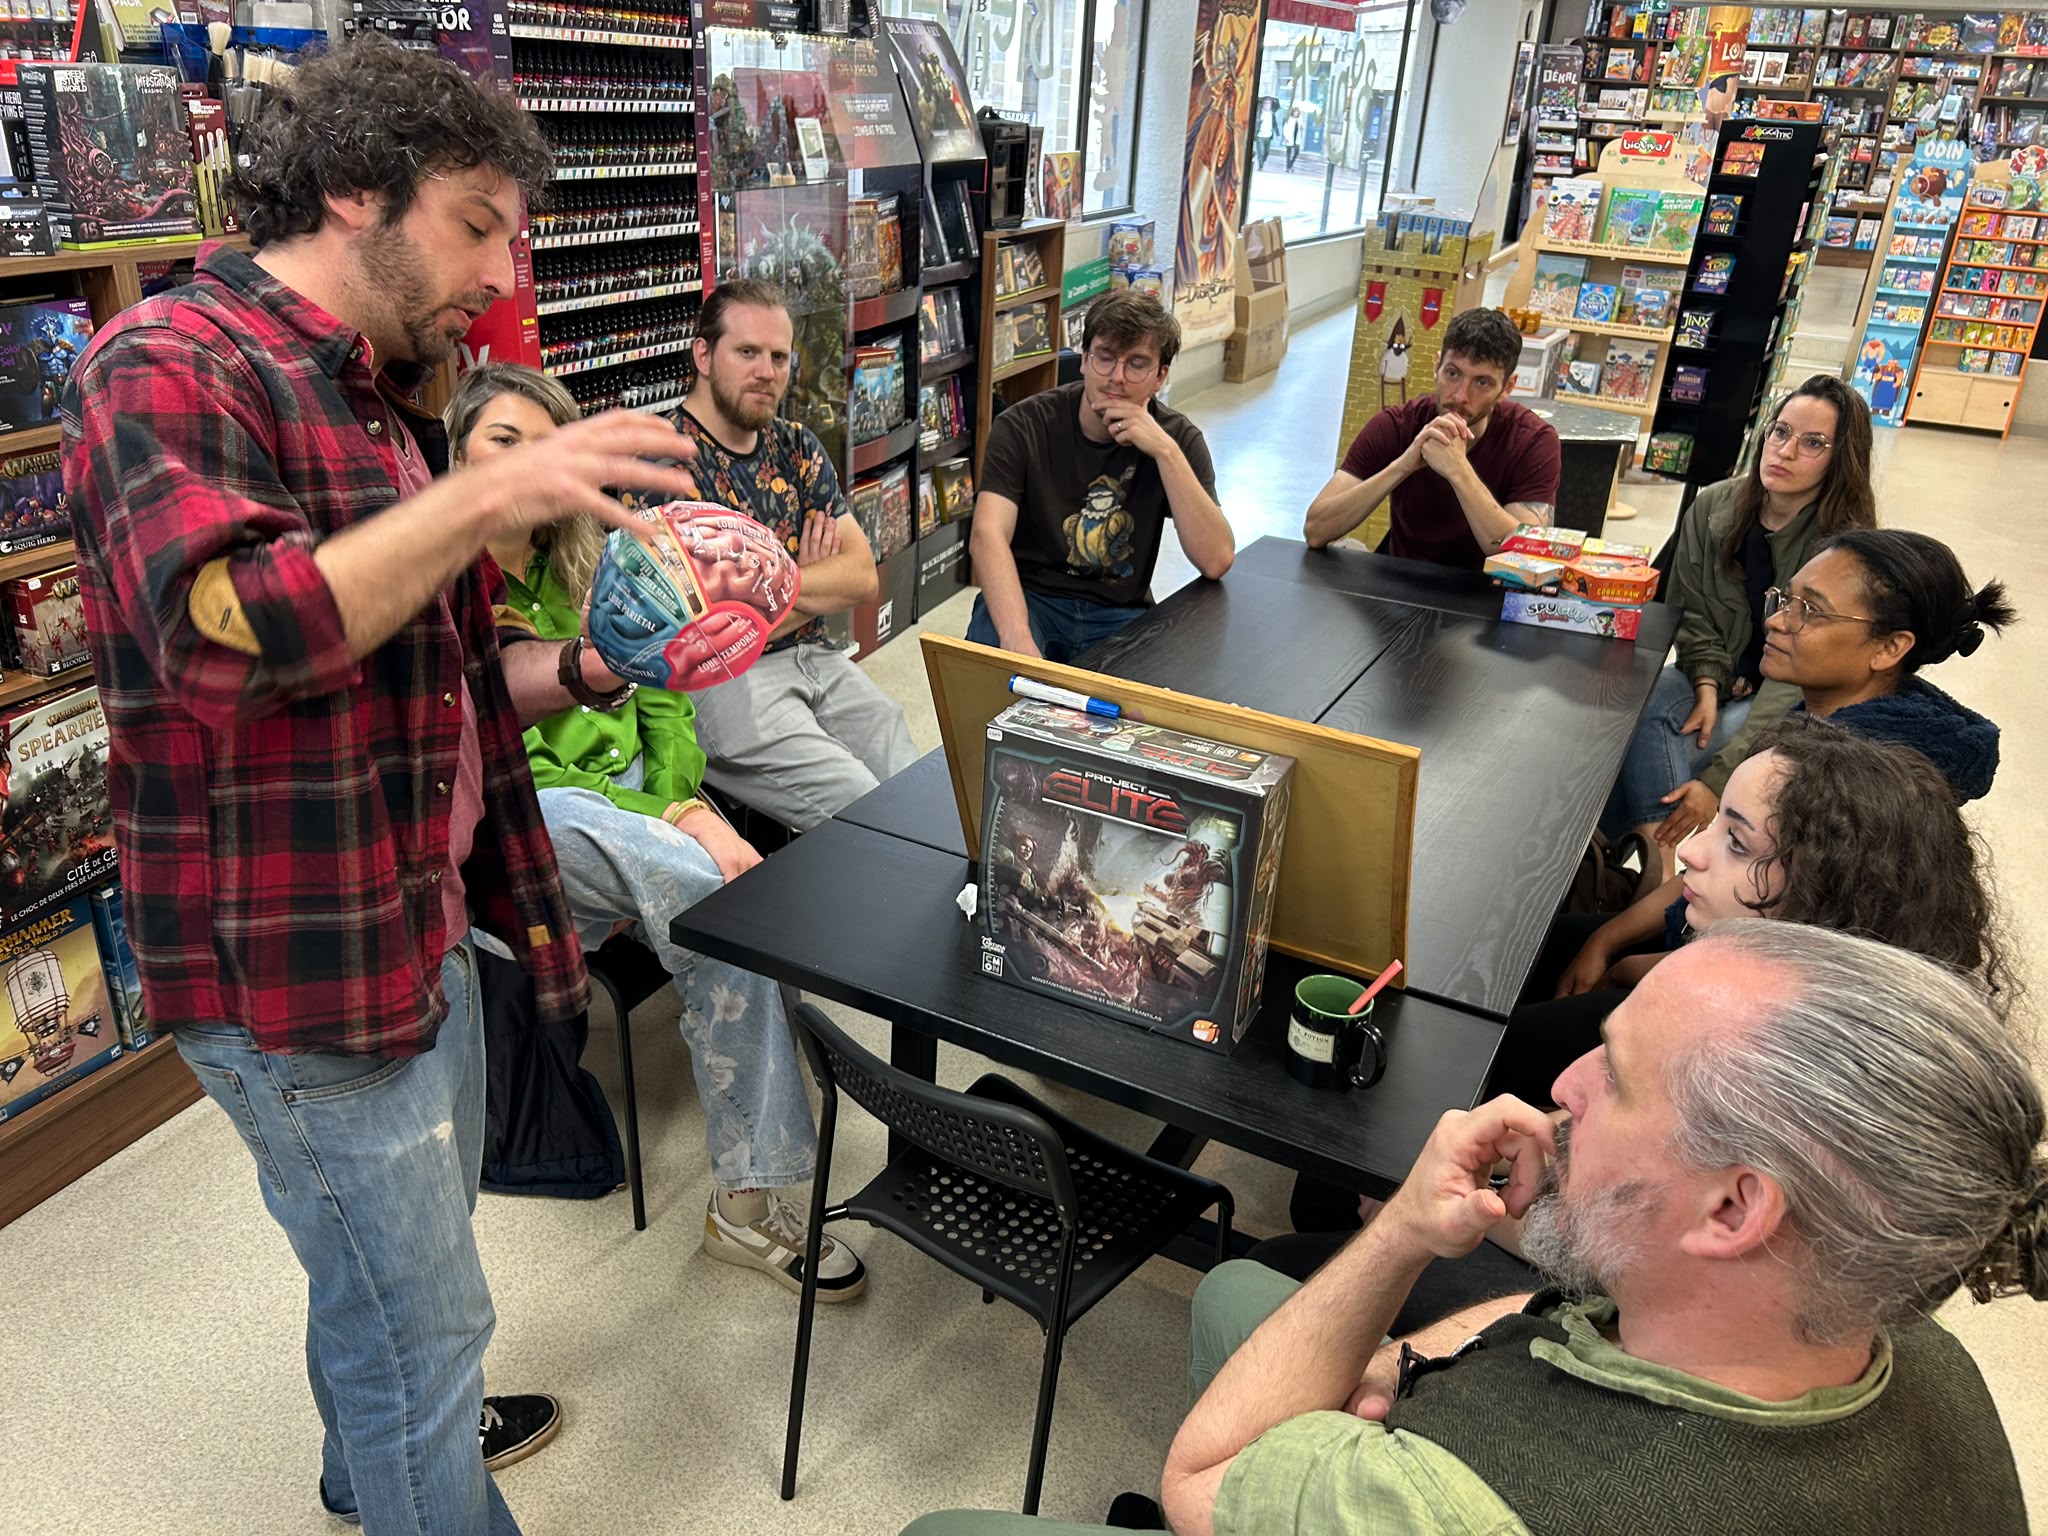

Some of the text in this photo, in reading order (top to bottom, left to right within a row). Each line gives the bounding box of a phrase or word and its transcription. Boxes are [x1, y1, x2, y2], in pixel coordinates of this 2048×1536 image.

[886, 22, 940, 37] BLACK LIBRARY
[1543, 67, 1577, 85] DÉKAL
[1923, 140, 1965, 161] ODIN
[1681, 314, 1711, 330] JINX
[13, 539, 37, 552] SQUIG
[37, 535, 57, 546] HERD
[1597, 588, 1640, 598] COBRA PAW
[622, 605, 656, 632] PARIÉTAL
[698, 628, 760, 674] LOBE TEMPORAL
[18, 712, 107, 763] SPEARHE
[1085, 770, 1147, 793] PROJECT
[1042, 769, 1188, 834] ELITE
[67, 858, 91, 881] CITÉ
[92, 857, 102, 867] DE
[10, 914, 19, 922] LE
[18, 902, 39, 918] CHOC
[39, 898, 48, 906] DE
[48, 889, 65, 902] DEUX
[64, 881, 79, 893] FERS
[78, 876, 87, 885] DE
[87, 865, 107, 880] LANCE
[0, 908, 76, 953] RHAMMER
[13, 944, 30, 955] OLD
[30, 930, 58, 946] WORLD
[1031, 976, 1072, 992] KONSTANTINOS
[1132, 1007, 1162, 1022] TSANTILAS
[1304, 1032, 1329, 1043] POTION
